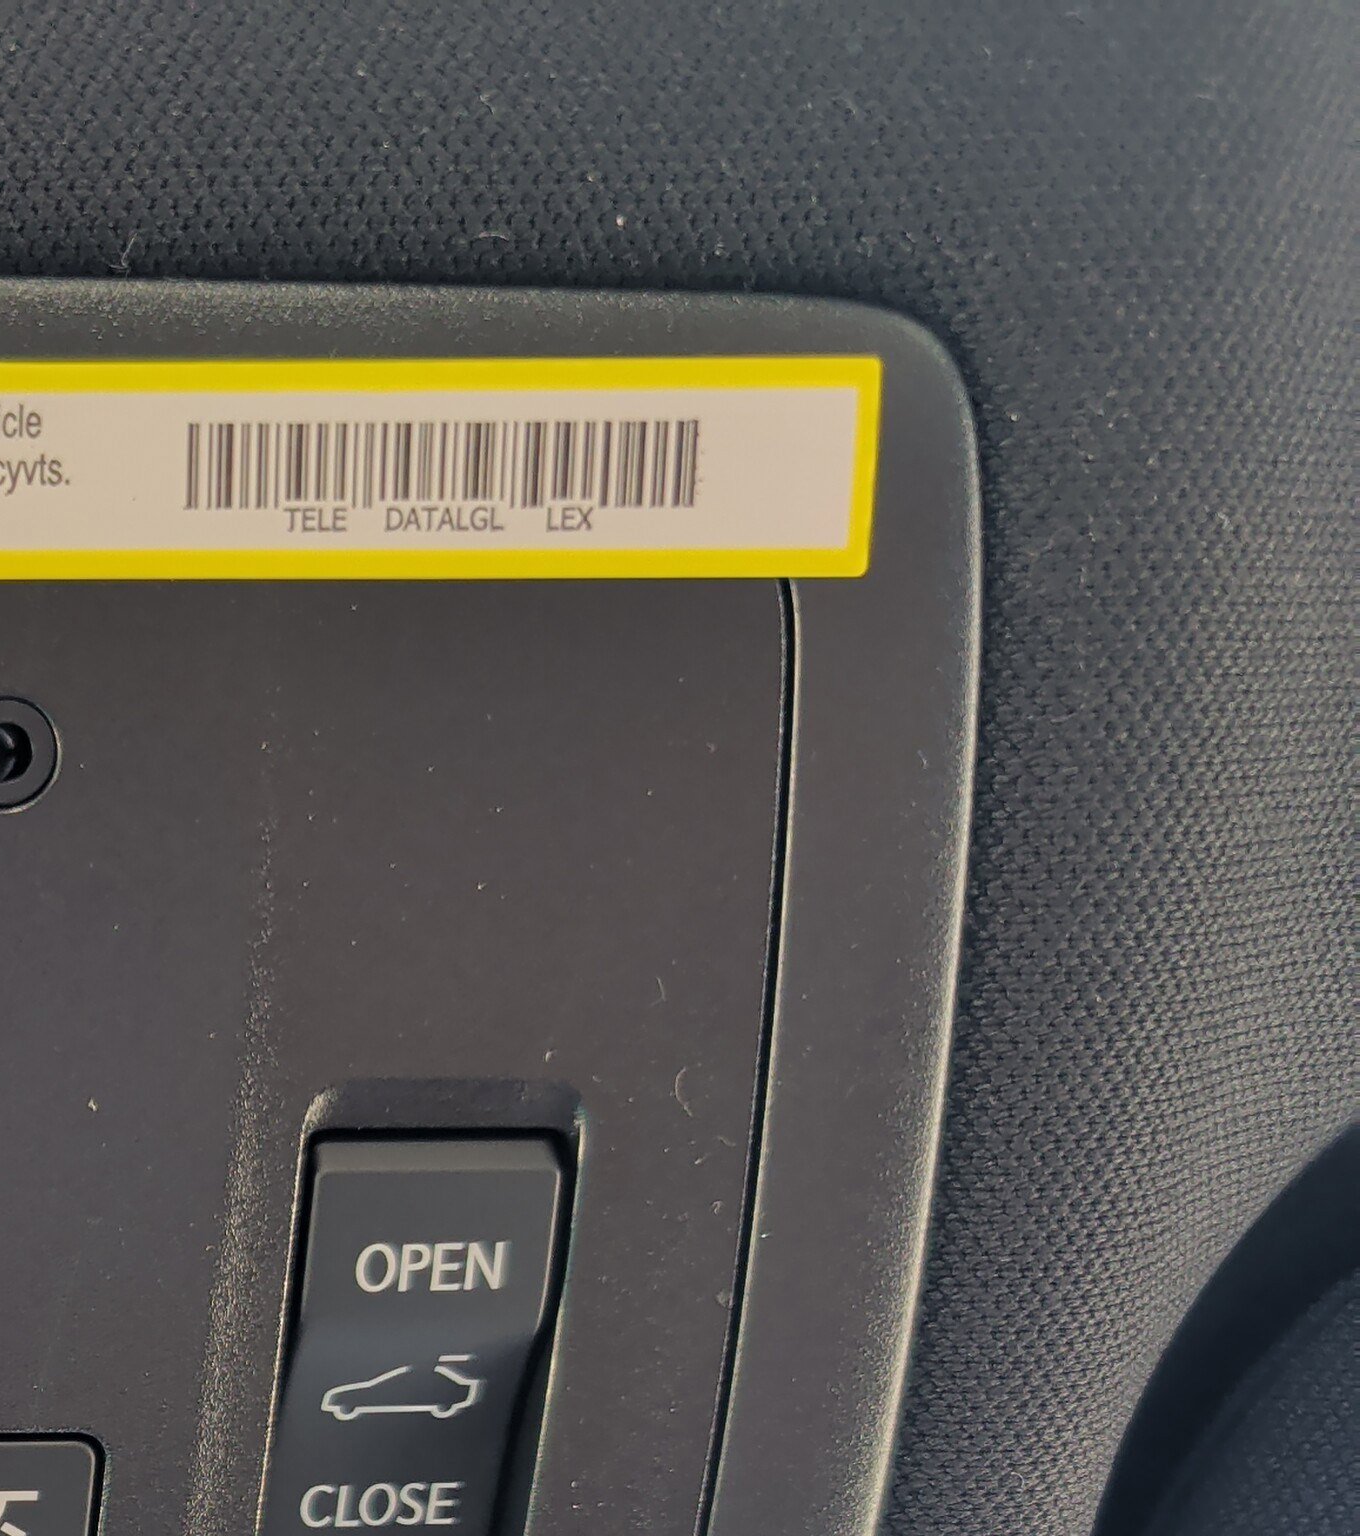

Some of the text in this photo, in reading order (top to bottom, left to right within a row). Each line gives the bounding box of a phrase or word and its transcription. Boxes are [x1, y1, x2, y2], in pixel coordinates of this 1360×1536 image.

[282, 504, 595, 534] TELE DATALGL LEX
[354, 1241, 510, 1293] OPEN
[299, 1481, 466, 1528] CLOSE
